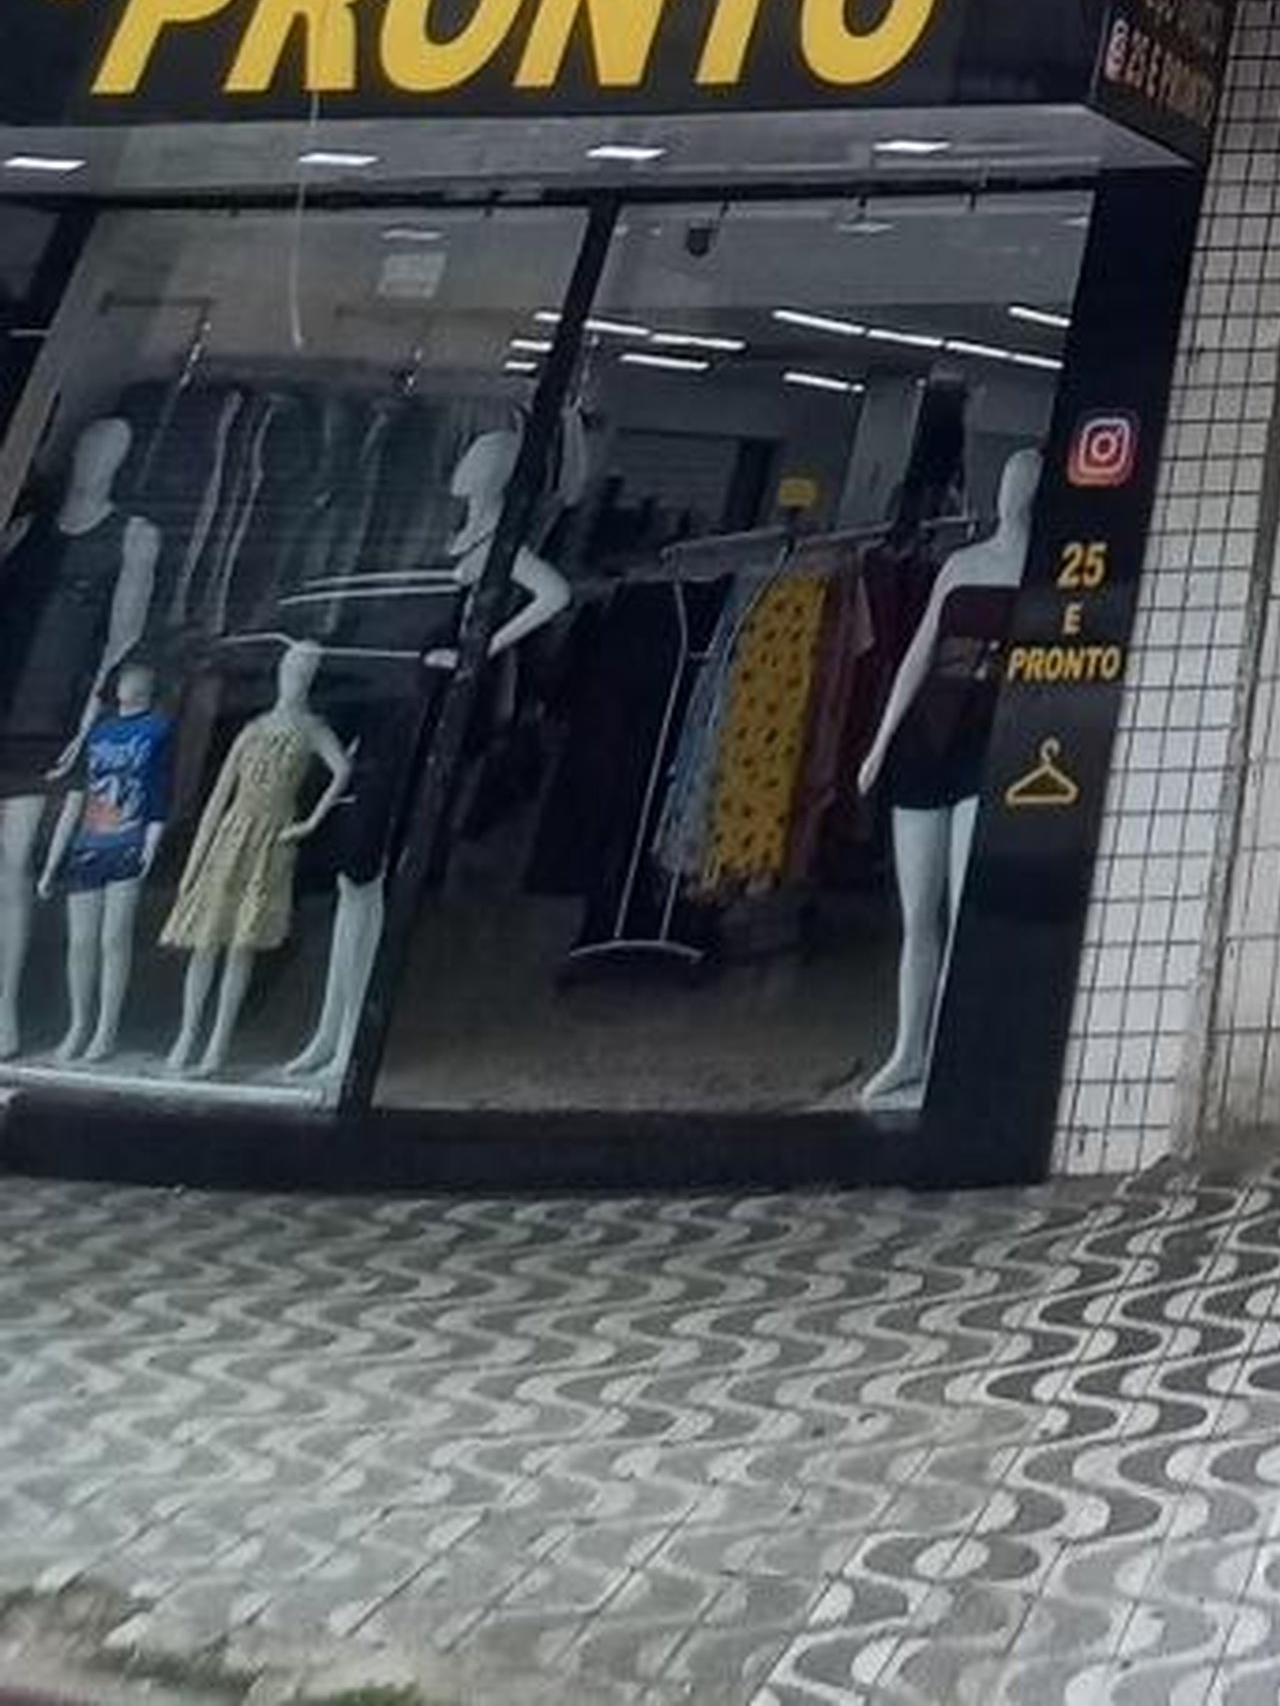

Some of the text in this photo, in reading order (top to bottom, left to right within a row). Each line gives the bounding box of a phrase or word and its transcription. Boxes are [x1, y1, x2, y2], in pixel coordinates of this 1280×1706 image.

[1056, 541, 1108, 588] 25
[1061, 603, 1083, 634] E
[1007, 646, 1122, 682] PRONTO
